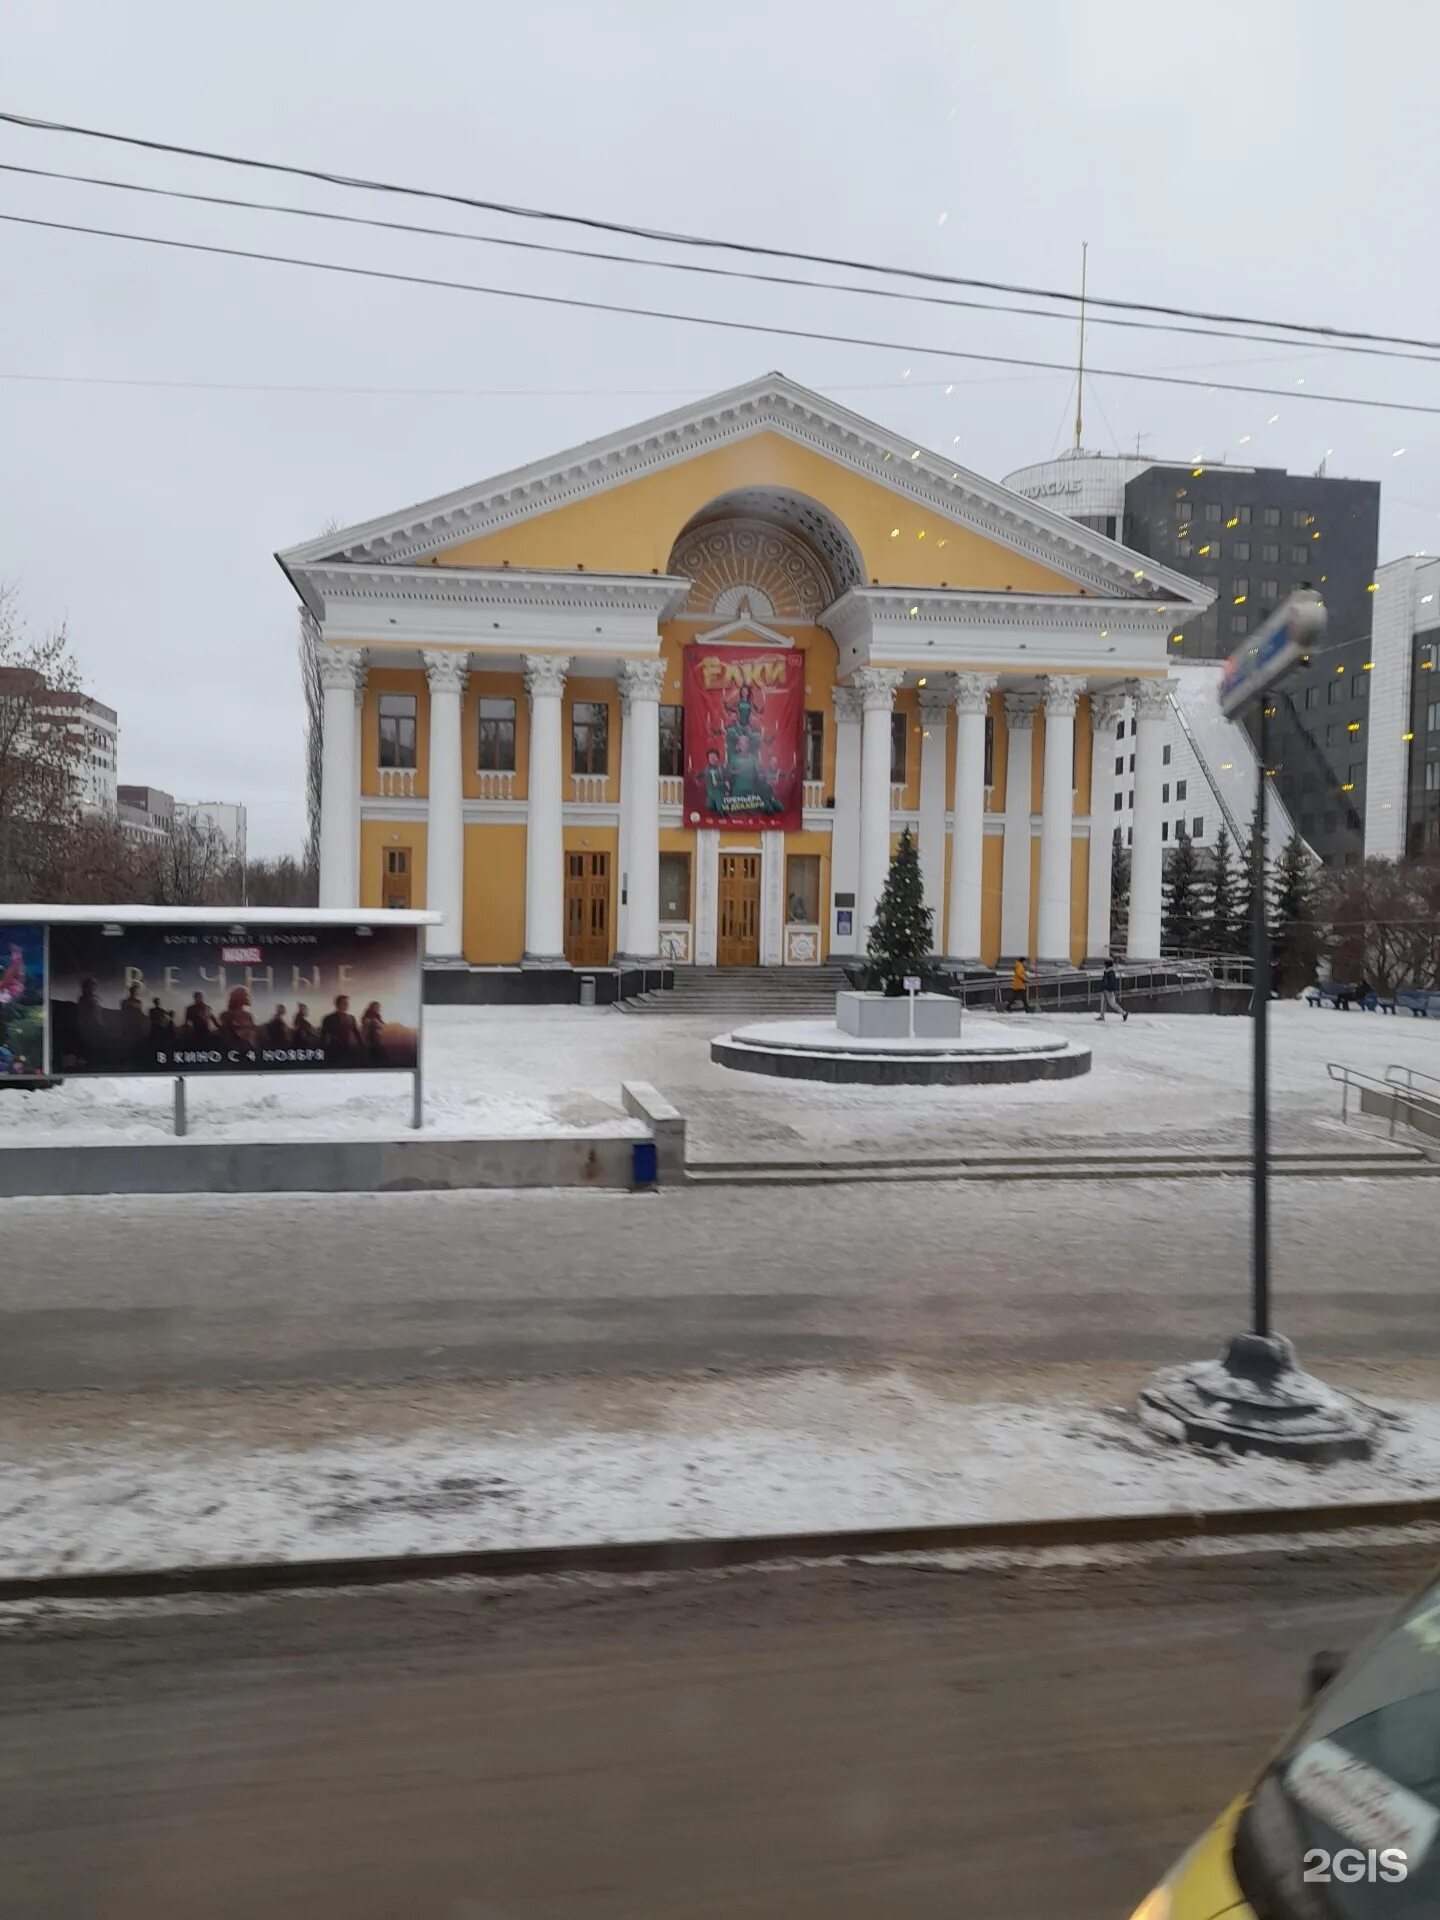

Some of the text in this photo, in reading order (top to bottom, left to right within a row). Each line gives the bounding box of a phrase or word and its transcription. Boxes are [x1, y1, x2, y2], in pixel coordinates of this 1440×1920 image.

[124, 965, 353, 996] ВЕЧНЫЕ
[157, 1049, 325, 1063] В КИНО С 4 НОЯБРЯ
